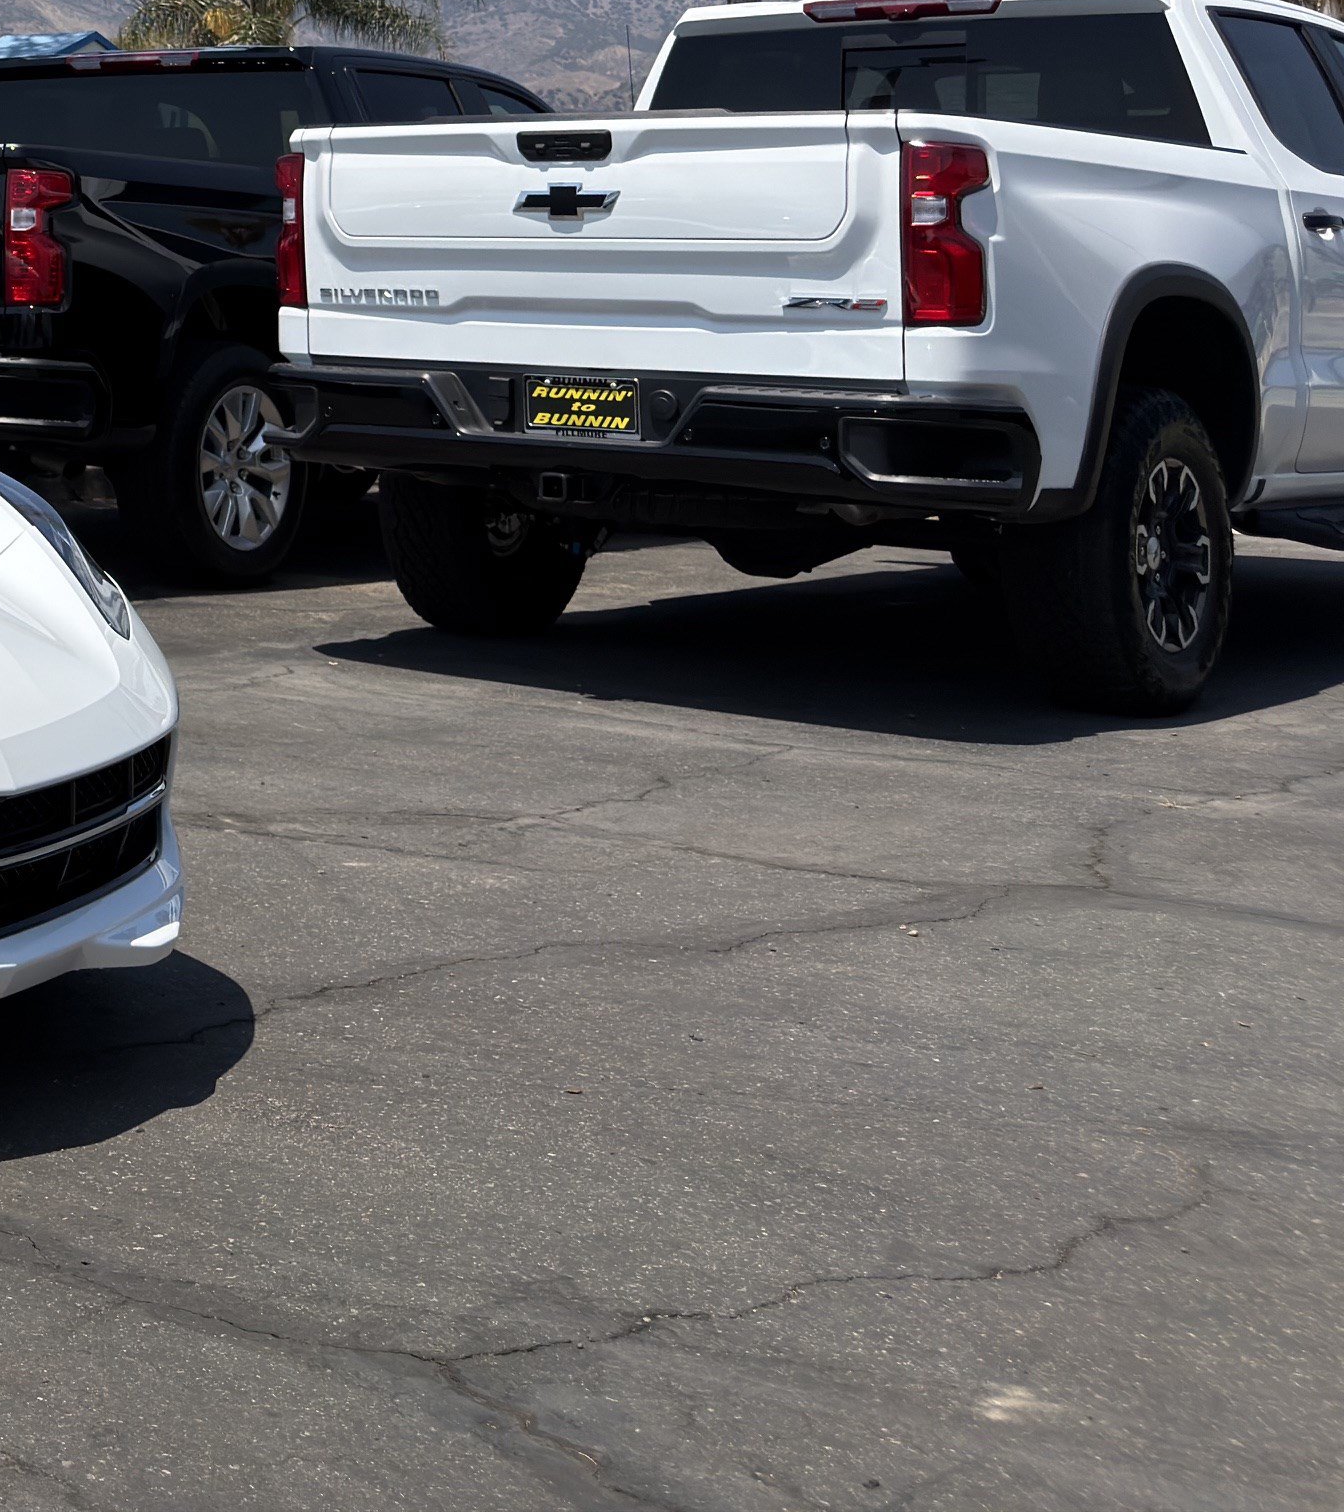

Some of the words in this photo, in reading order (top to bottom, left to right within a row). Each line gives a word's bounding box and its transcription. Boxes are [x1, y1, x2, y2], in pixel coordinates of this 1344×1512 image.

[319, 287, 440, 305] SILVERADO
[570, 401, 596, 412] to
[532, 412, 630, 429] BUNNIN
